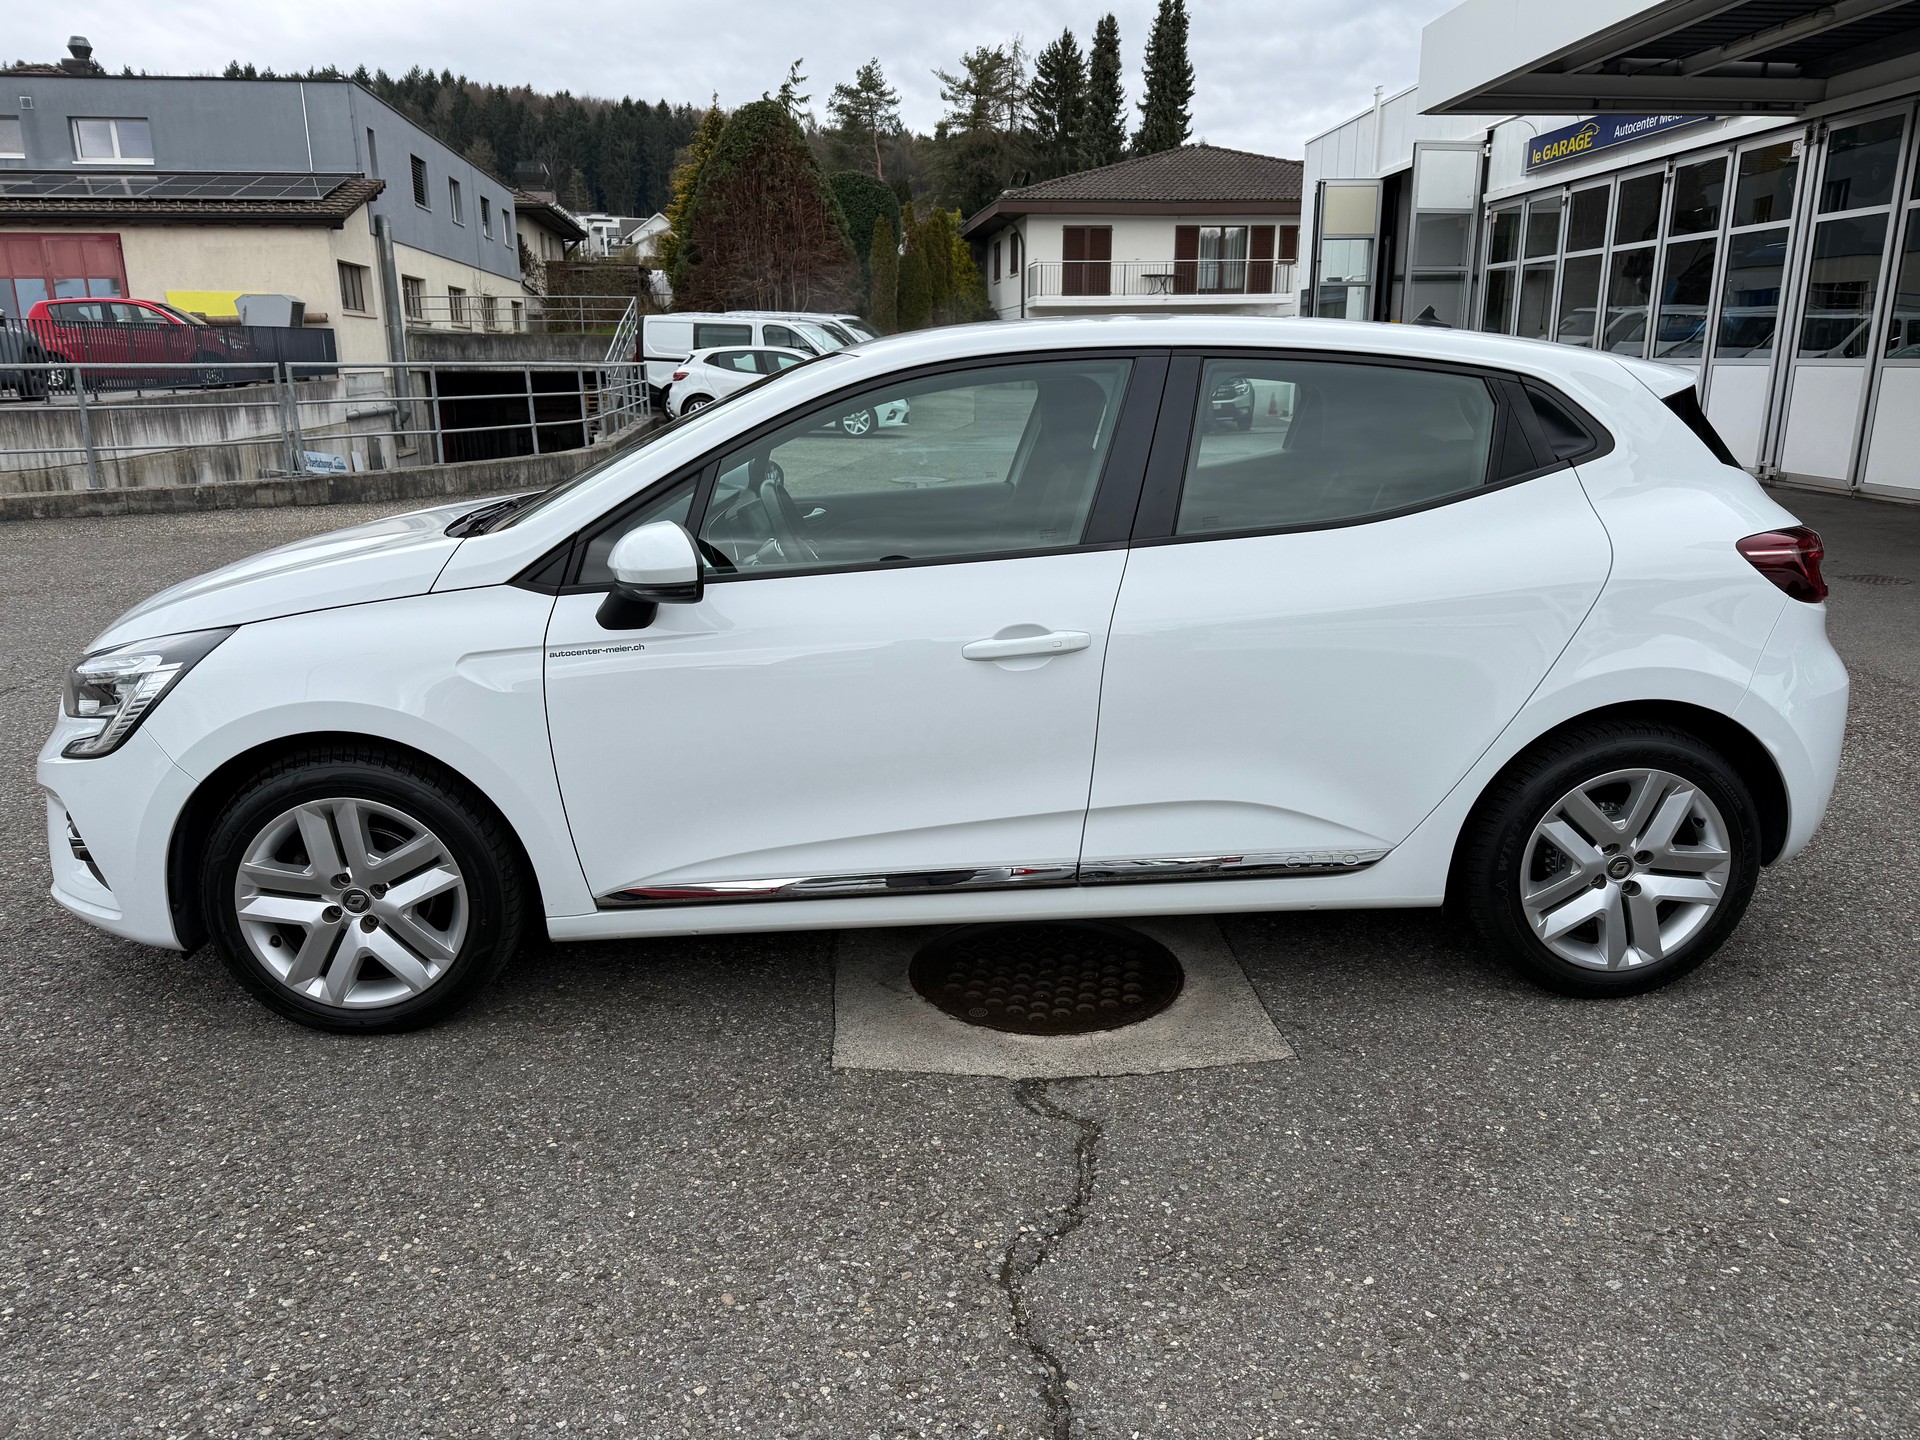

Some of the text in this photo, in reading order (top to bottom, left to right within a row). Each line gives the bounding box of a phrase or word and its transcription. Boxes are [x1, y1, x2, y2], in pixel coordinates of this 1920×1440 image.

[1614, 115, 1658, 138] Autocenter
[1532, 132, 1593, 164] le GARAGE
[549, 643, 645, 658] autocenter-meier.ch
[1285, 854, 1359, 868] CLIO
